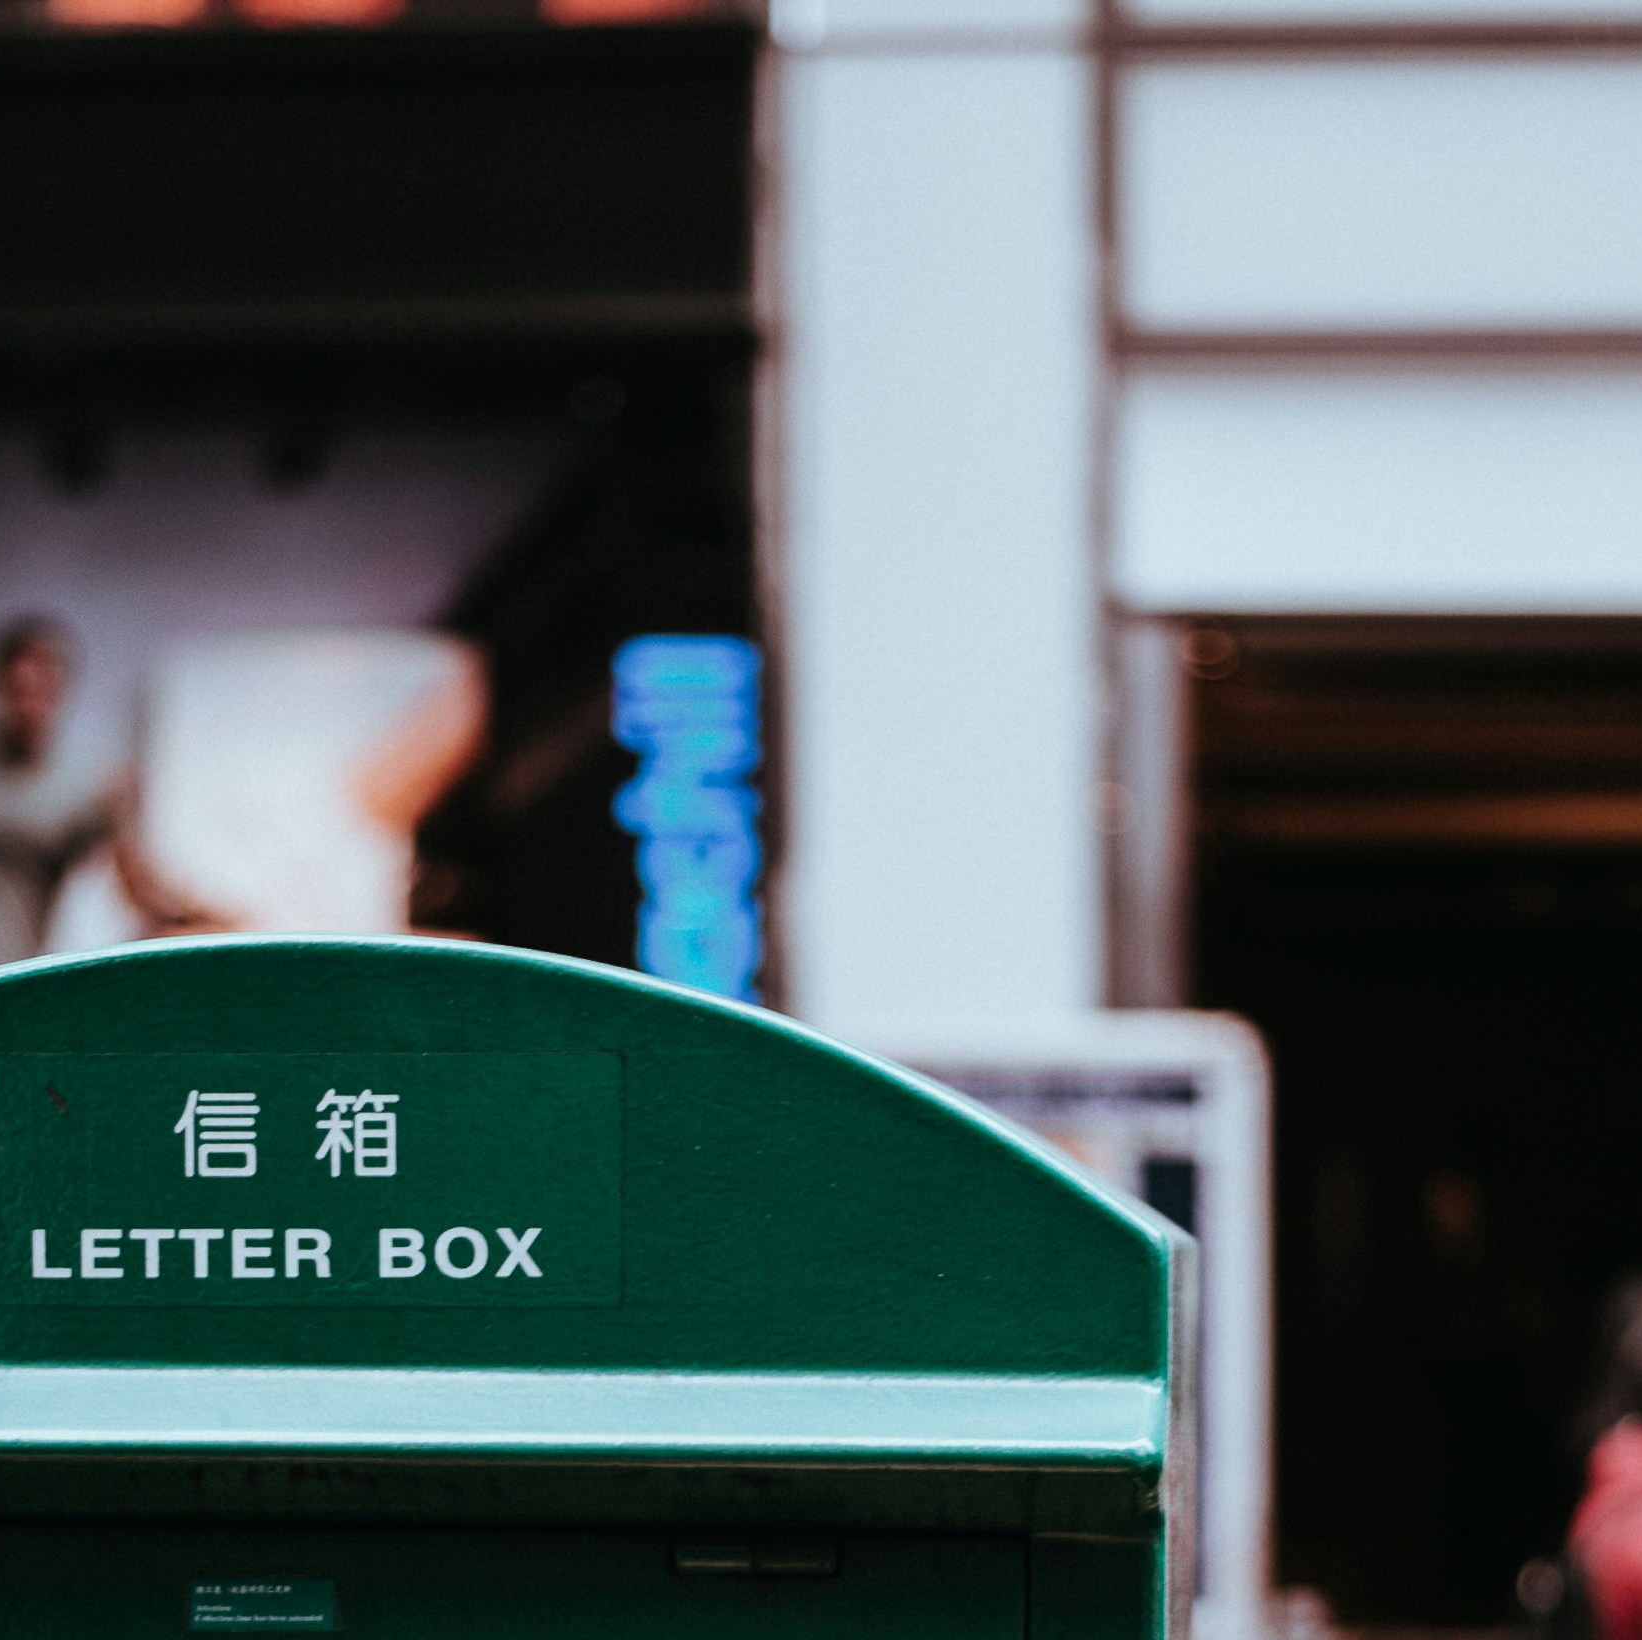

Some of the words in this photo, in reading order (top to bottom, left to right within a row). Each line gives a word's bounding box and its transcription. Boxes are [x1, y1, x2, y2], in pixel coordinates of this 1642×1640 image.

[174, 1089, 400, 1178] 信箱
[31, 1227, 332, 1279] LETTER
[378, 1226, 544, 1279] BOX
